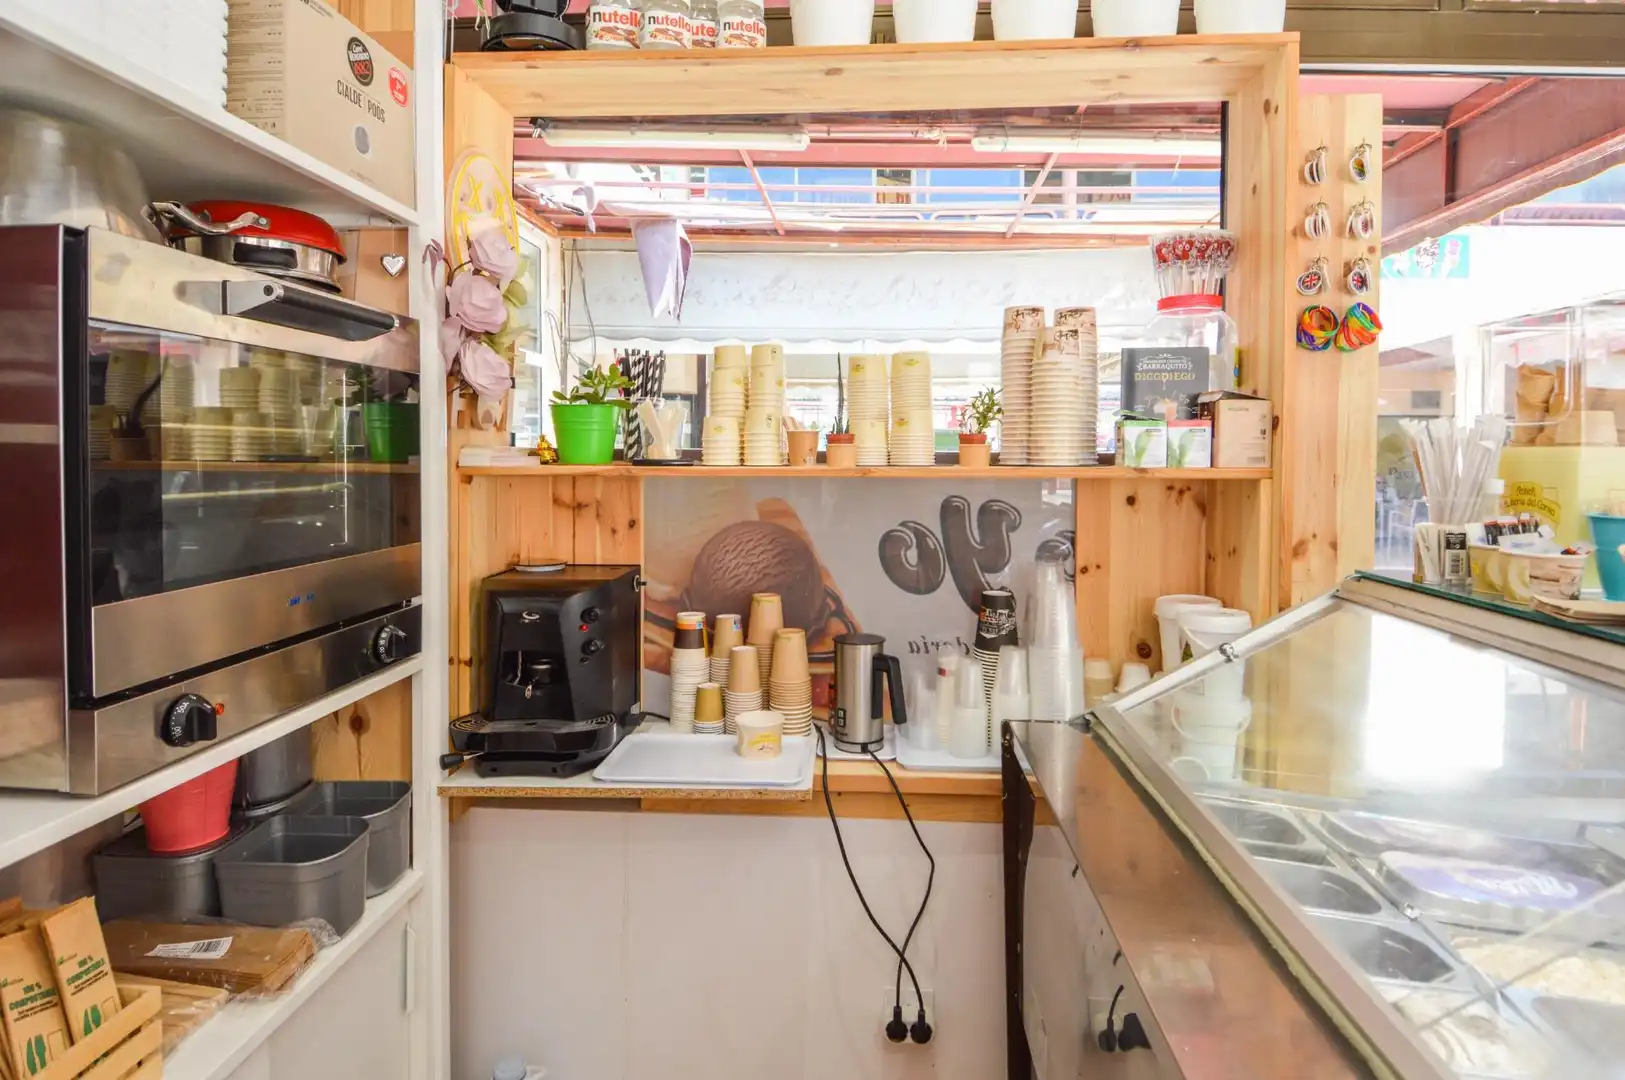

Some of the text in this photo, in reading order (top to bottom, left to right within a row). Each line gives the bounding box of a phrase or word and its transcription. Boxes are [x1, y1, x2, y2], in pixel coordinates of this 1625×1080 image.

[648, 15, 691, 32] nutella
[723, 21, 765, 36] nutella
[336, 79, 362, 108] CIALDE
[367, 99, 385, 123] PODS
